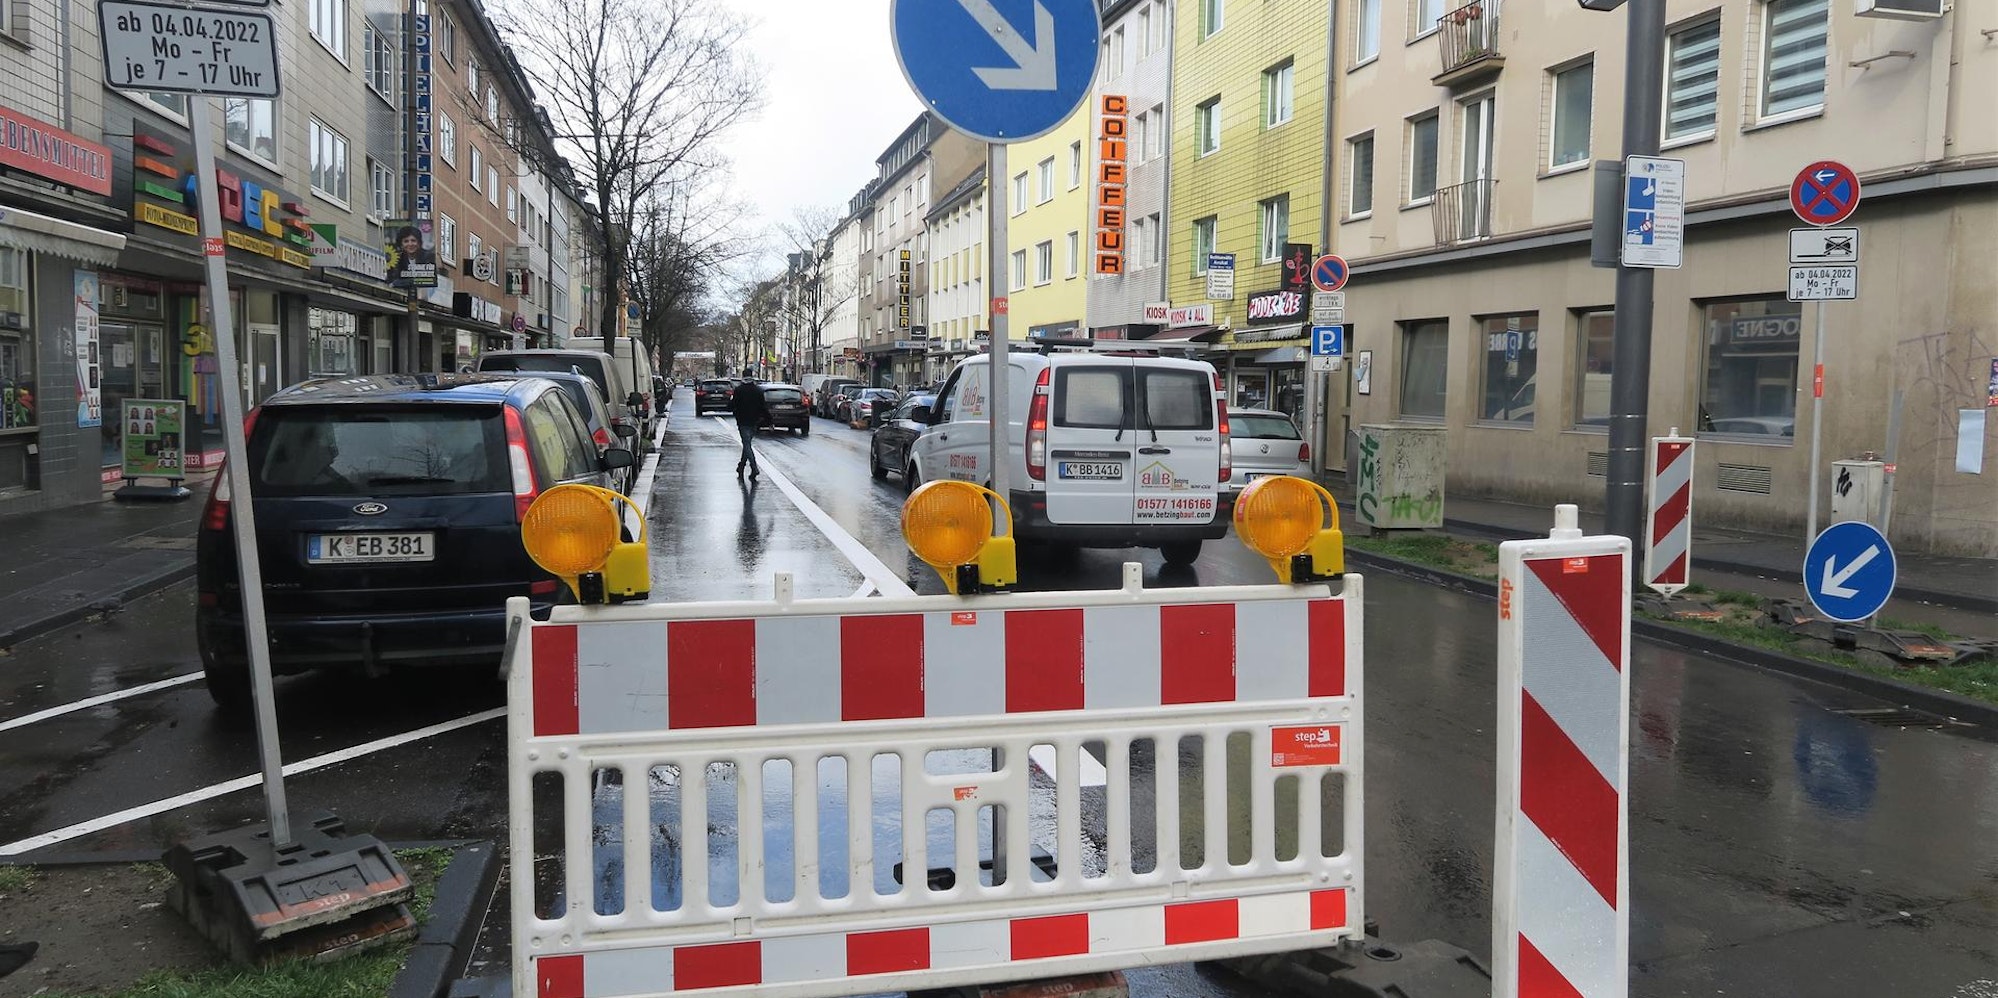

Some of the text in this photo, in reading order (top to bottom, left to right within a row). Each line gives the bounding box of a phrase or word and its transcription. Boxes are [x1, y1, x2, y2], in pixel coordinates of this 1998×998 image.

[117, 11, 260, 43] ab 04.04.2022
[151, 36, 181, 59] Mo
[212, 41, 231, 63] Fr
[126, 57, 145, 83] je
[155, 60, 165, 80] 7
[199, 63, 218, 84] 17
[229, 65, 262, 87] Uhr
[1101, 96, 1124, 272] COIFFEUR
[1795, 269, 1852, 279] ab 04.04.2022
[901, 250, 910, 327] MITTLER
[1807, 279, 1819, 287] Mo
[1830, 279, 1840, 287] Fr
[1795, 288, 1804, 299] je
[1807, 288, 1812, 297] 7
[1824, 288, 1833, 296] 17
[1836, 287, 1850, 296] Uhr
[1146, 307, 1167, 319] KIOSK
[1170, 310, 1187, 324] KIOSK
[1194, 308, 1205, 321] ALL
[1066, 464, 1120, 474] K BB 1416
[1137, 498, 1212, 509] 01577 1416166
[1137, 511, 1210, 519] www.betzingbaut.com
[329, 536, 424, 557] K EB 381
[1500, 578, 1514, 620] step
[1295, 731, 1316, 743] step
[1041, 982, 1073, 994] step
